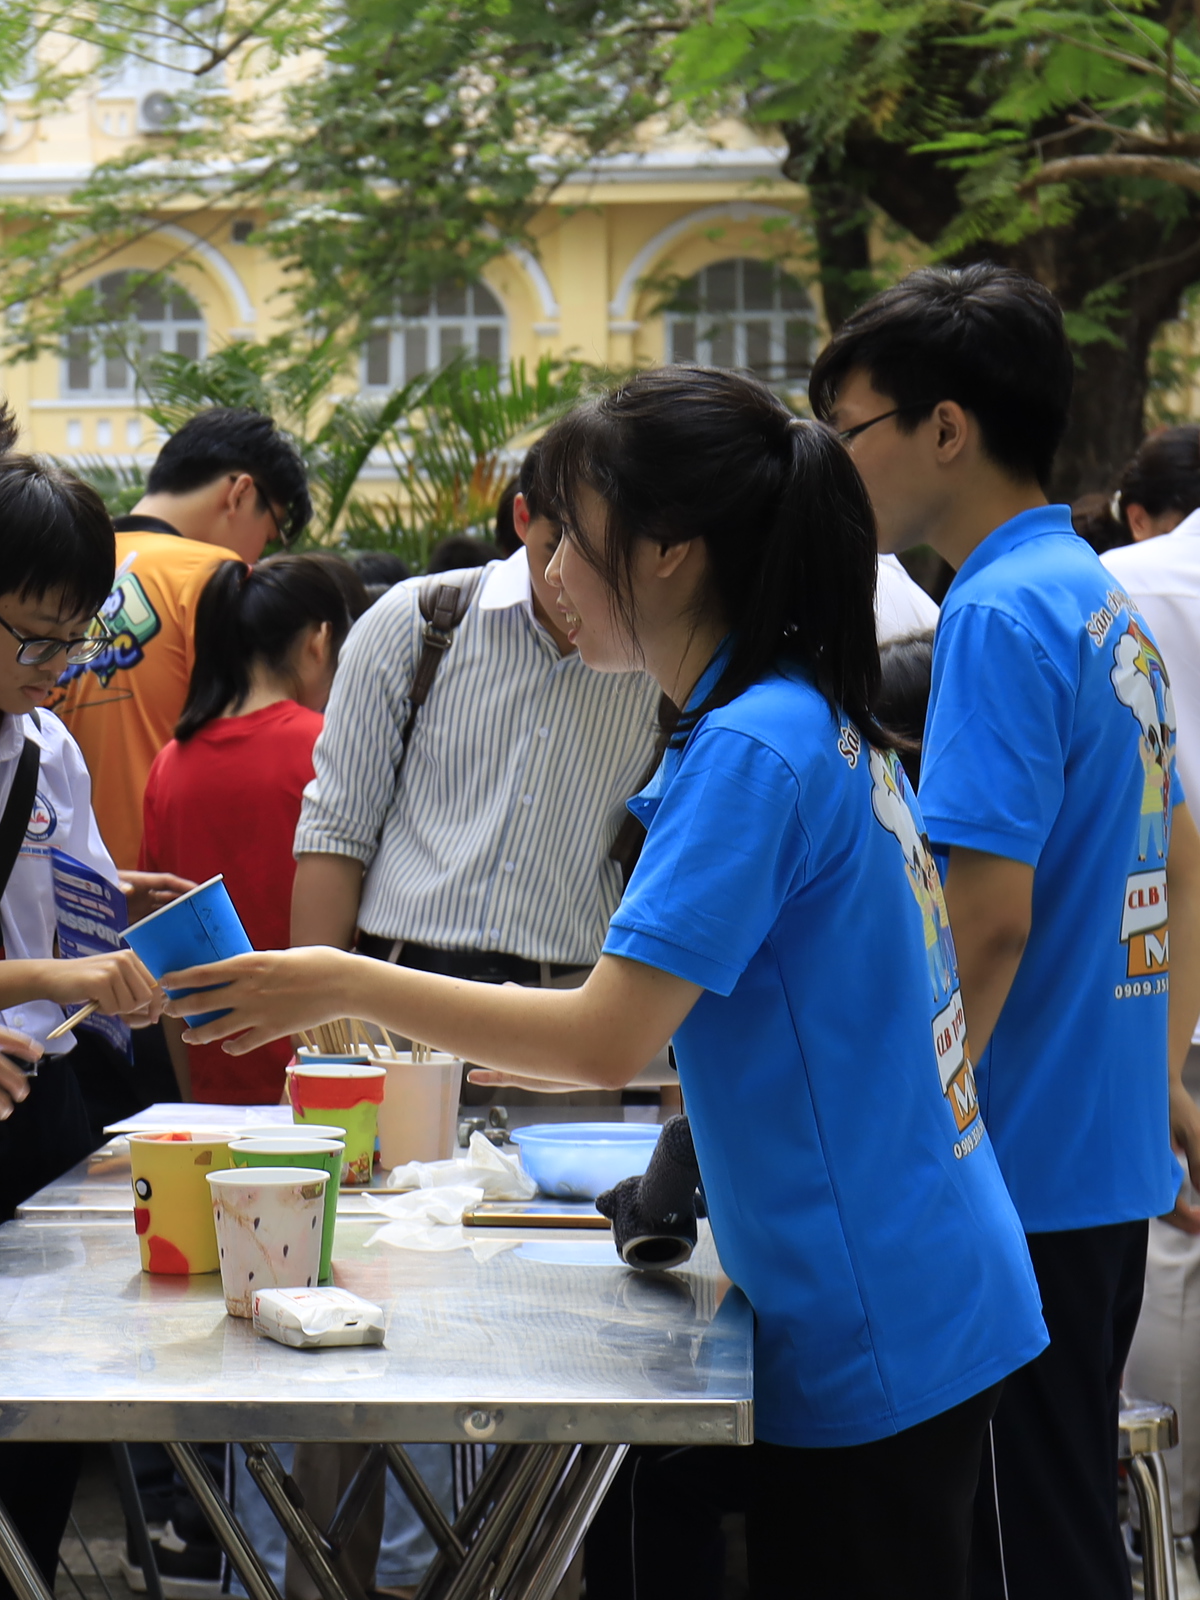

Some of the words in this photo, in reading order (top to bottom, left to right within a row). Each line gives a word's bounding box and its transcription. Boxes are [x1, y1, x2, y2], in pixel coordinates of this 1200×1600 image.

[1086, 607, 1112, 647] Sân
[1128, 886, 1160, 909] CLB
[937, 1027, 952, 1057] CLB
